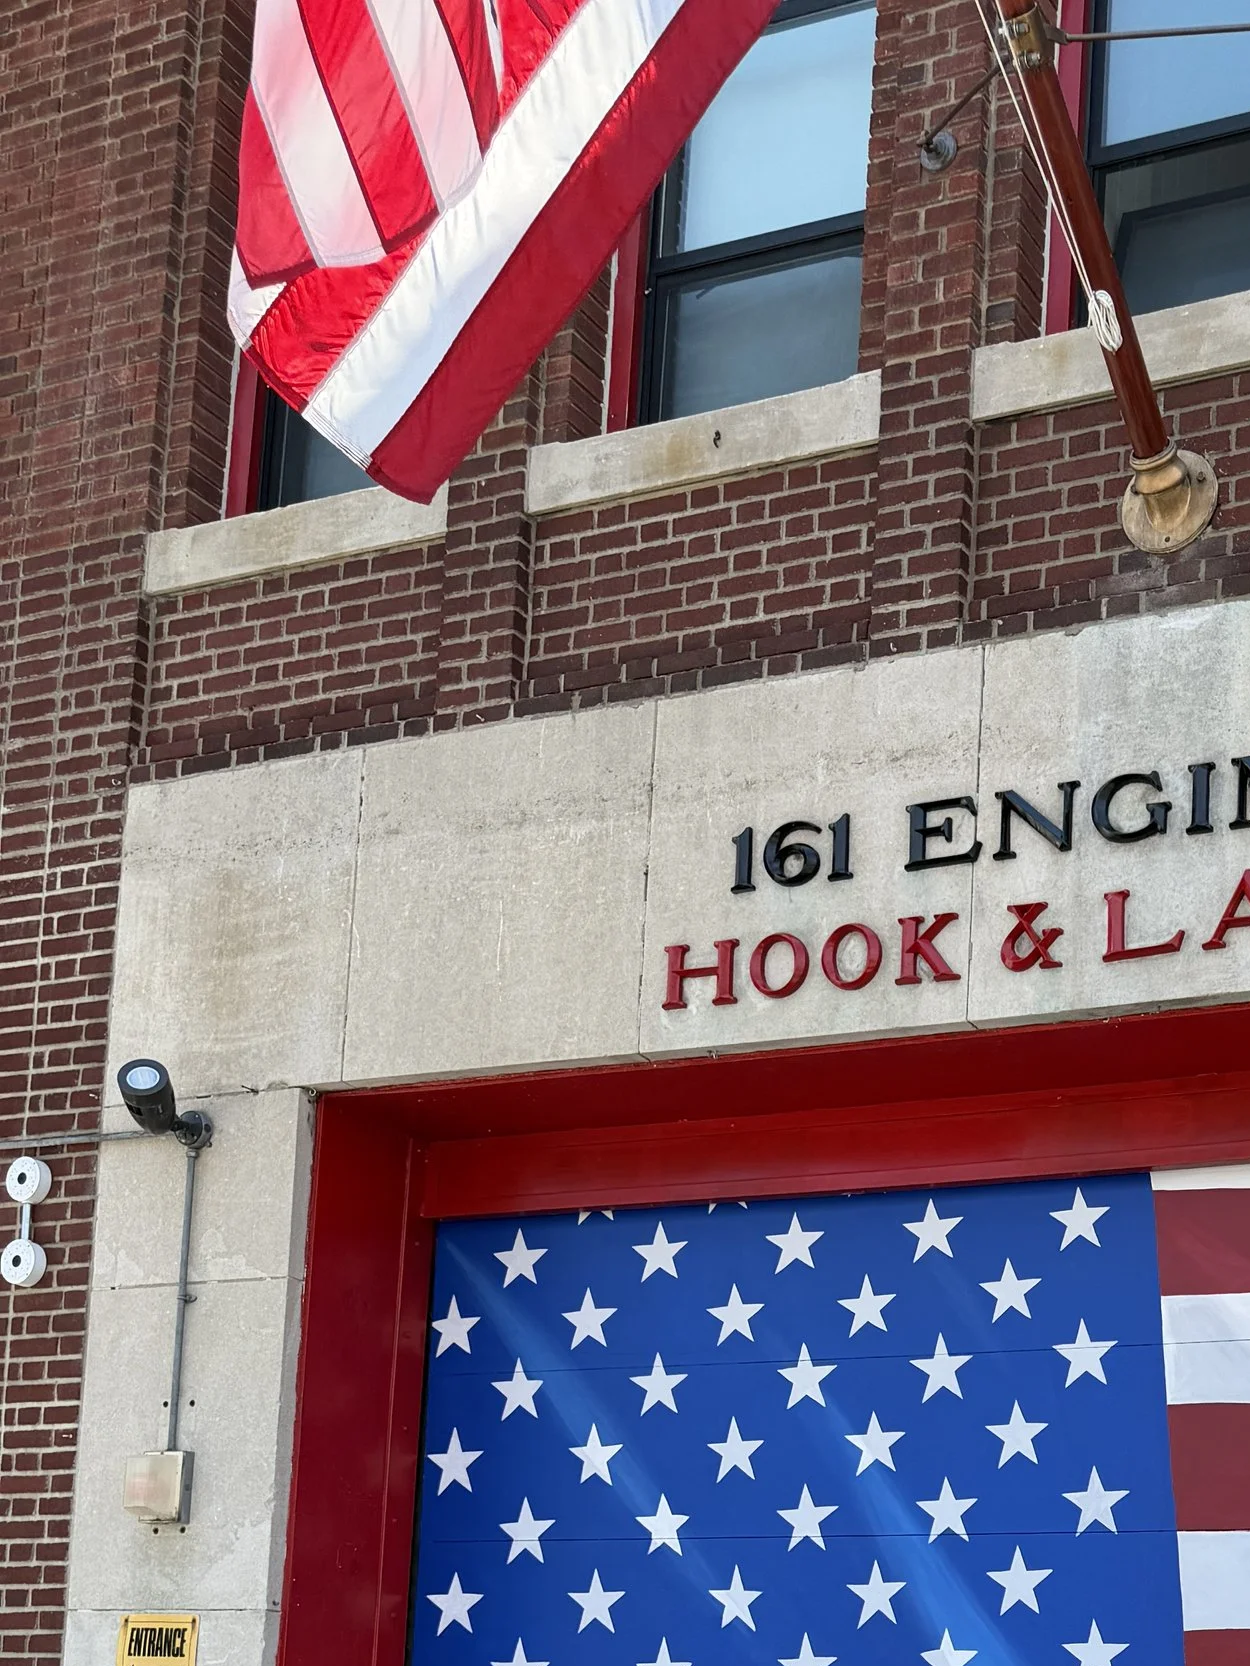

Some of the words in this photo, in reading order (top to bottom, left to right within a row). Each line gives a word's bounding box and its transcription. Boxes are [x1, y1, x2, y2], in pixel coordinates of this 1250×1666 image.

[731, 812, 854, 894] 161
[661, 911, 960, 1011] HOOK
[1000, 900, 1064, 971] &
[127, 1627, 188, 1658] ENTRANCE
